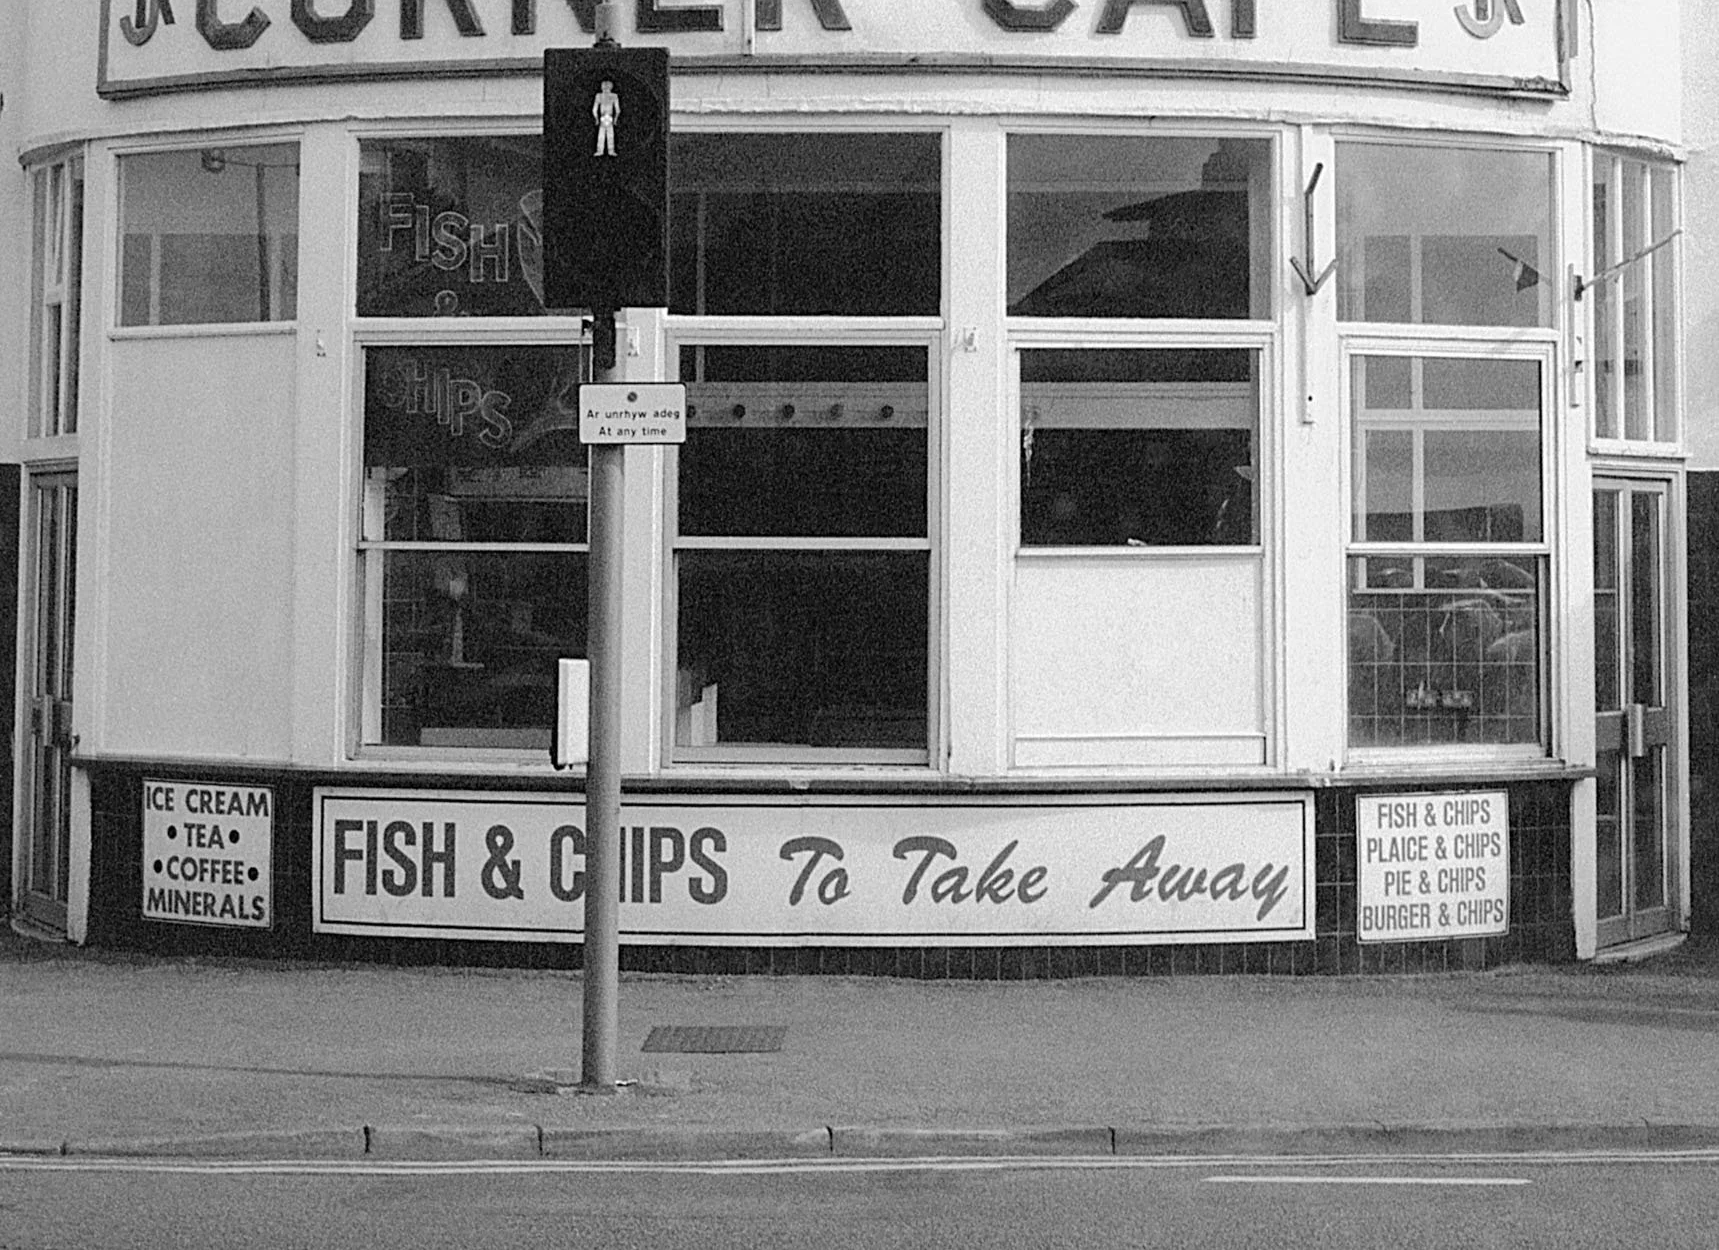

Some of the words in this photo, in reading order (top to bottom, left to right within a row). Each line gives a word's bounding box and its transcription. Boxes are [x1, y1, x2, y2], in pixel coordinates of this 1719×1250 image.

[380, 192, 509, 283] FISH
[586, 409, 599, 419] Ar
[605, 410, 647, 420] unrhyw
[653, 409, 680, 420] adeg
[599, 426, 612, 436] At
[617, 428, 636, 438] any
[642, 427, 667, 436] time
[146, 785, 175, 812] ICE
[185, 788, 269, 817] CREAM
[1377, 802, 1417, 829] FISH
[1424, 802, 1437, 827] &
[1443, 799, 1490, 826] CHIPS
[184, 822, 225, 849] TEA
[1367, 835, 1428, 863] PLAICE
[1435, 835, 1447, 860] &
[1454, 832, 1501, 859] CHIPS
[167, 855, 245, 885] COFFEE
[334, 819, 456, 897] FISH
[481, 824, 524, 900] &
[549, 825, 728, 905] CIPS
[779, 836, 851, 906] To
[892, 836, 1048, 906] Take
[1088, 834, 1289, 922] Away
[1384, 870, 1411, 897] PIE
[1418, 869, 1431, 894] &
[1438, 866, 1486, 893] CHIPS
[147, 887, 266, 921] MINERALS
[1362, 903, 1430, 931] BURGER
[1438, 902, 1450, 927] &
[1457, 898, 1504, 926] CHIPS
